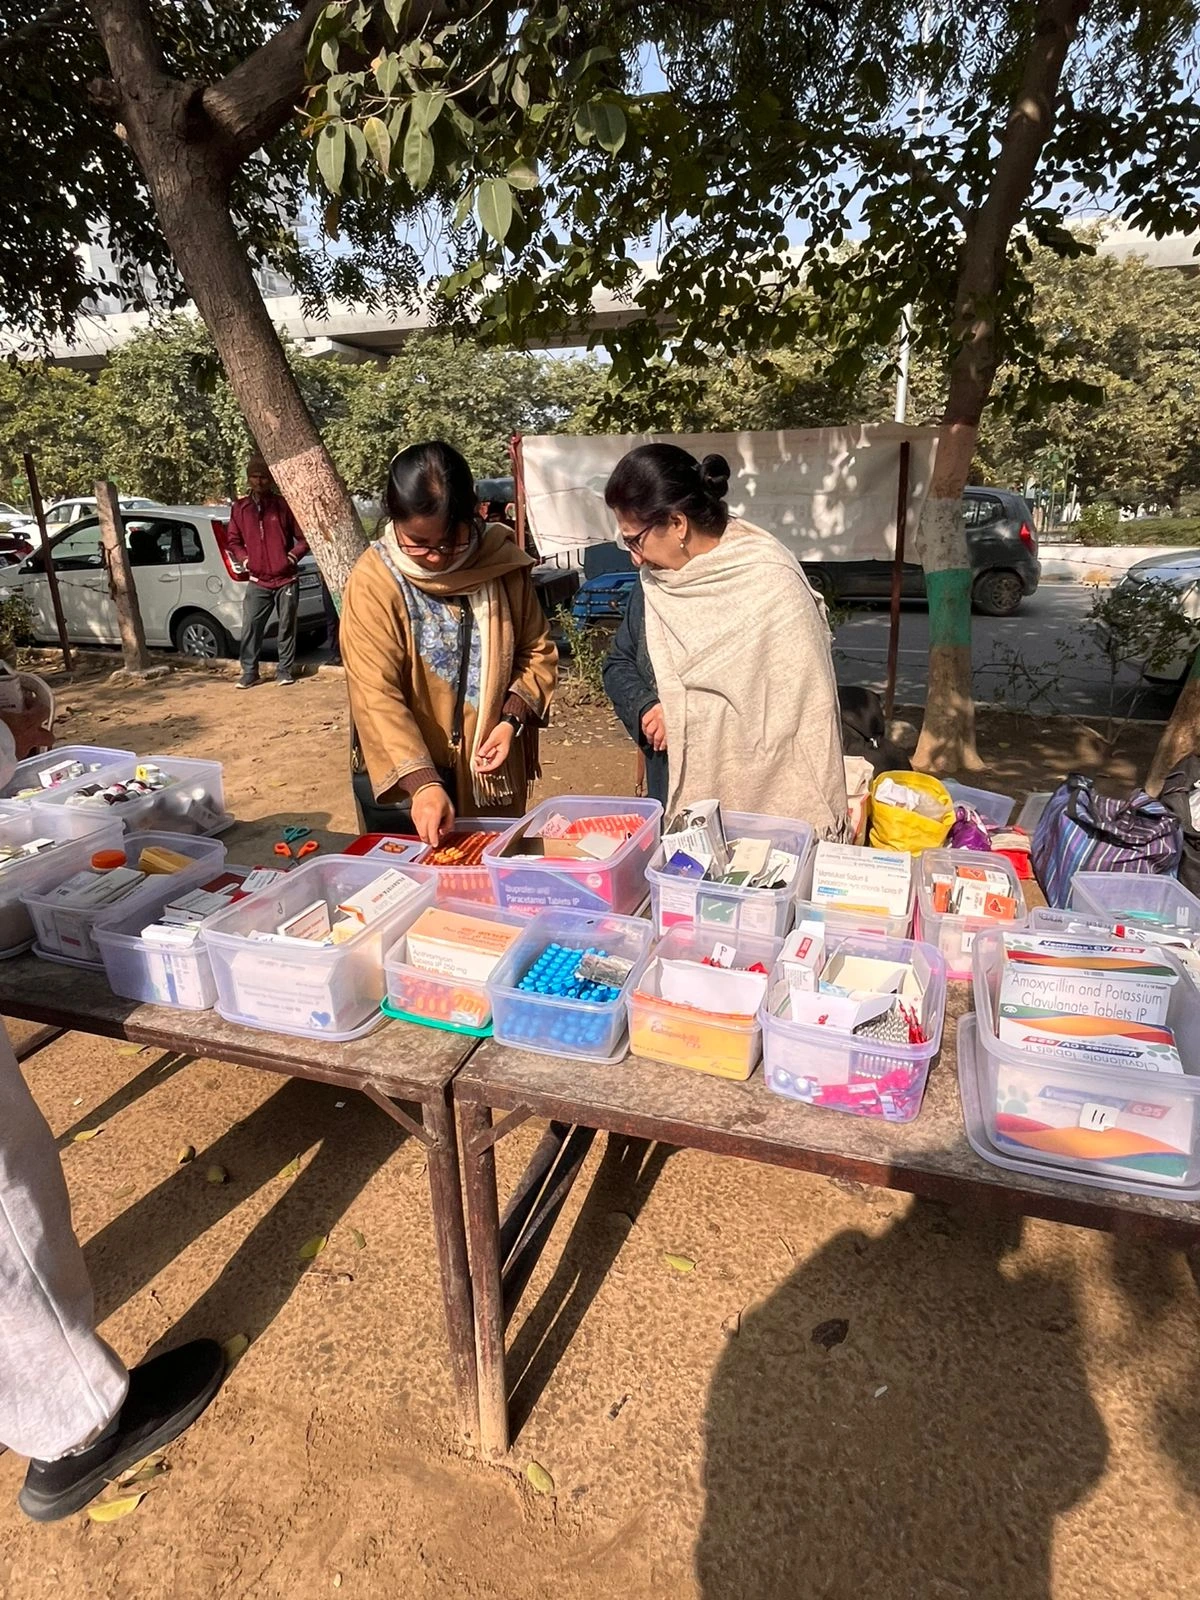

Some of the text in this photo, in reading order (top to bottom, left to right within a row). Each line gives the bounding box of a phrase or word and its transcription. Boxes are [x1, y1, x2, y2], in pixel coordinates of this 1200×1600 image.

[506, 894, 580, 906] Paracetamol Tablets IP
[1012, 973, 1163, 1004] Amoxycillin and Potassium
[1022, 991, 1148, 1021] Clavulanate Tablets IP
[1091, 1108, 1106, 1125] 11
[1132, 1104, 1164, 1118] 625
